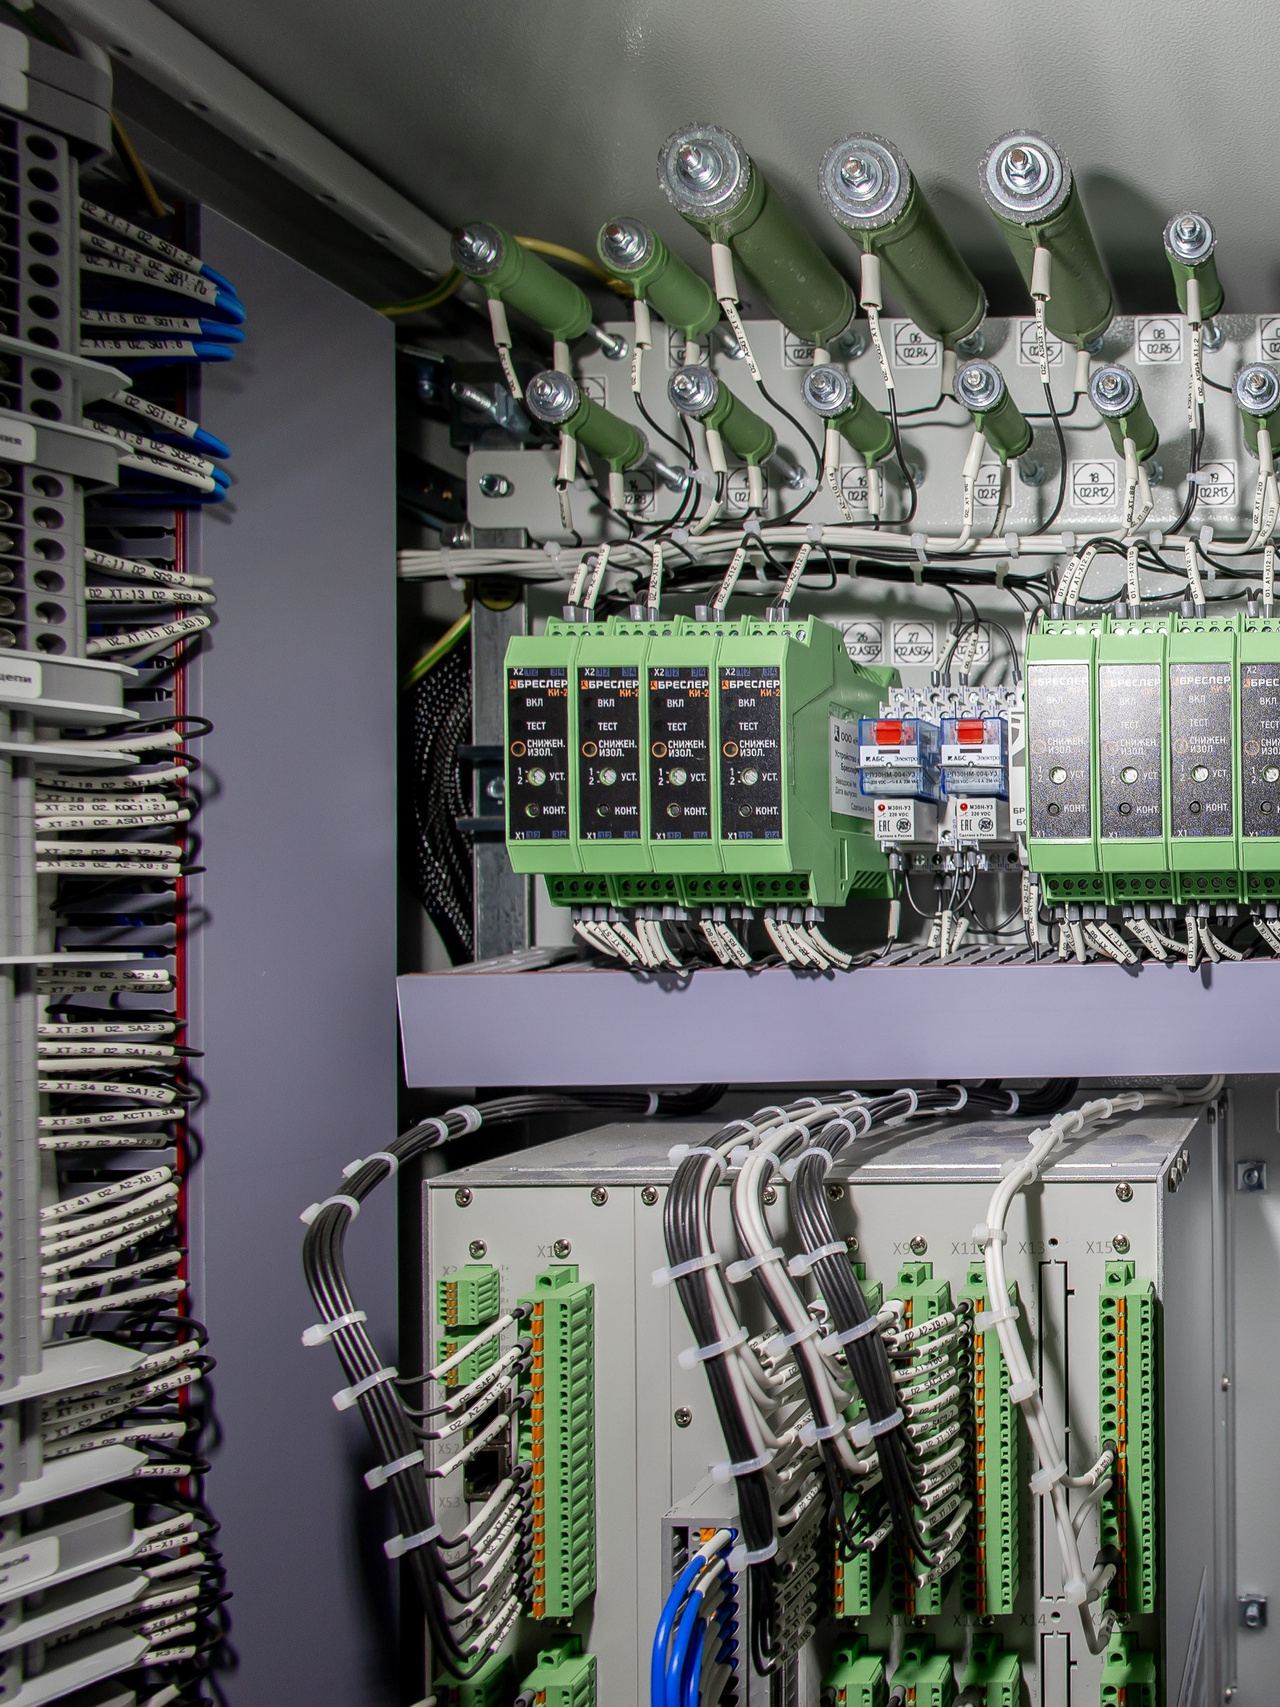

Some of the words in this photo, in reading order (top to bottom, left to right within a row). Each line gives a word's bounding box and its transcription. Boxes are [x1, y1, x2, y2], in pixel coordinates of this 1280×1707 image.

[910, 333, 921, 343] 06
[1153, 329, 1165, 340] 08
[1090, 473, 1099, 482] 18
[1210, 473, 1219, 482] 19
[908, 632, 919, 642] 27
[517, 680, 568, 689] БРЕСЛЕР
[589, 680, 639, 689] БРЕСЛЕР
[658, 680, 709, 689] БРЕСЛЕР
[730, 680, 780, 689] БРЕСЛЕР
[526, 698, 543, 706] ВКЛ
[598, 699, 614, 707] ВКЛ
[667, 699, 684, 707] ВКЛ
[739, 699, 755, 707] ВКЛ
[527, 722, 546, 730] ТЕСТ
[598, 722, 617, 730] ТЕСТ
[668, 723, 687, 731] ТЕСТ
[739, 722, 758, 730] ТЕСТ
[1260, 720, 1279, 729] ТЕСТ
[893, 1243, 910, 1255] X9
[951, 1243, 978, 1255] X11
[1018, 1242, 1045, 1254] X13
[1086, 1242, 1113, 1254] X15
[1020, 1614, 1047, 1626] X14
